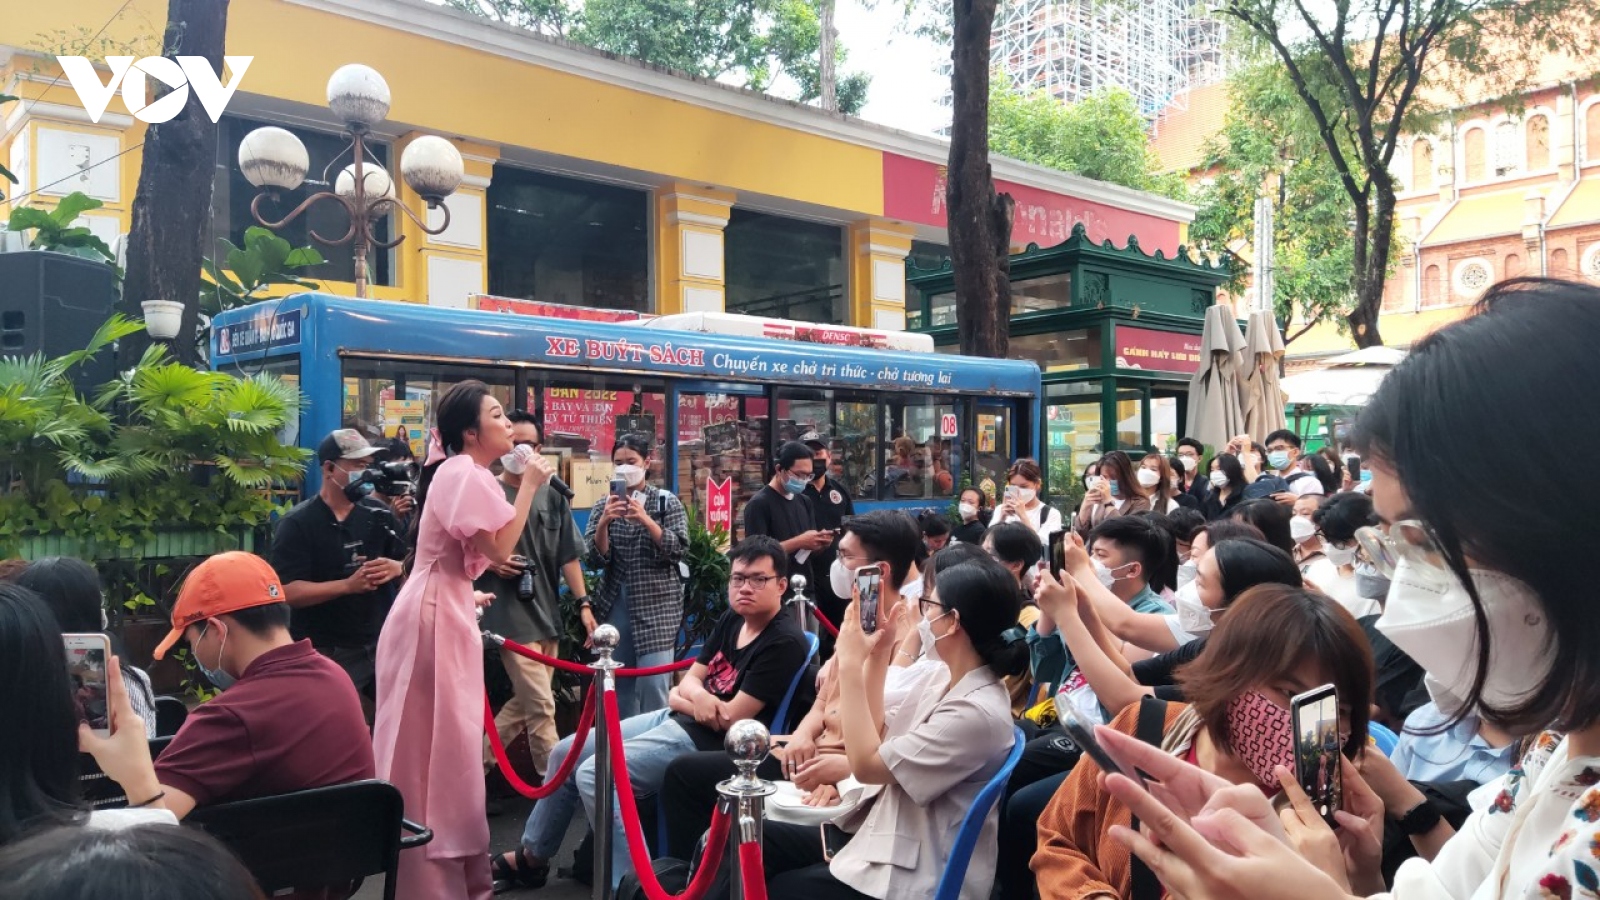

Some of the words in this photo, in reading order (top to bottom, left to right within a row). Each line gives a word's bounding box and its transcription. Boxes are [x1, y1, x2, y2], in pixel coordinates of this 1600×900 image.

[546, 336, 580, 356] XE
[585, 338, 645, 362] BUÝT
[650, 341, 705, 367] SÁCH
[713, 353, 767, 373] Chuyến
[771, 361, 788, 373] xe
[793, 360, 818, 376] chở
[821, 363, 836, 376] tri
[840, 363, 867, 379] thức
[877, 366, 899, 381] chở
[903, 370, 934, 385] tương
[938, 370, 952, 385] lai
[584, 389, 617, 400] 2022
[943, 415, 956, 434] 08
